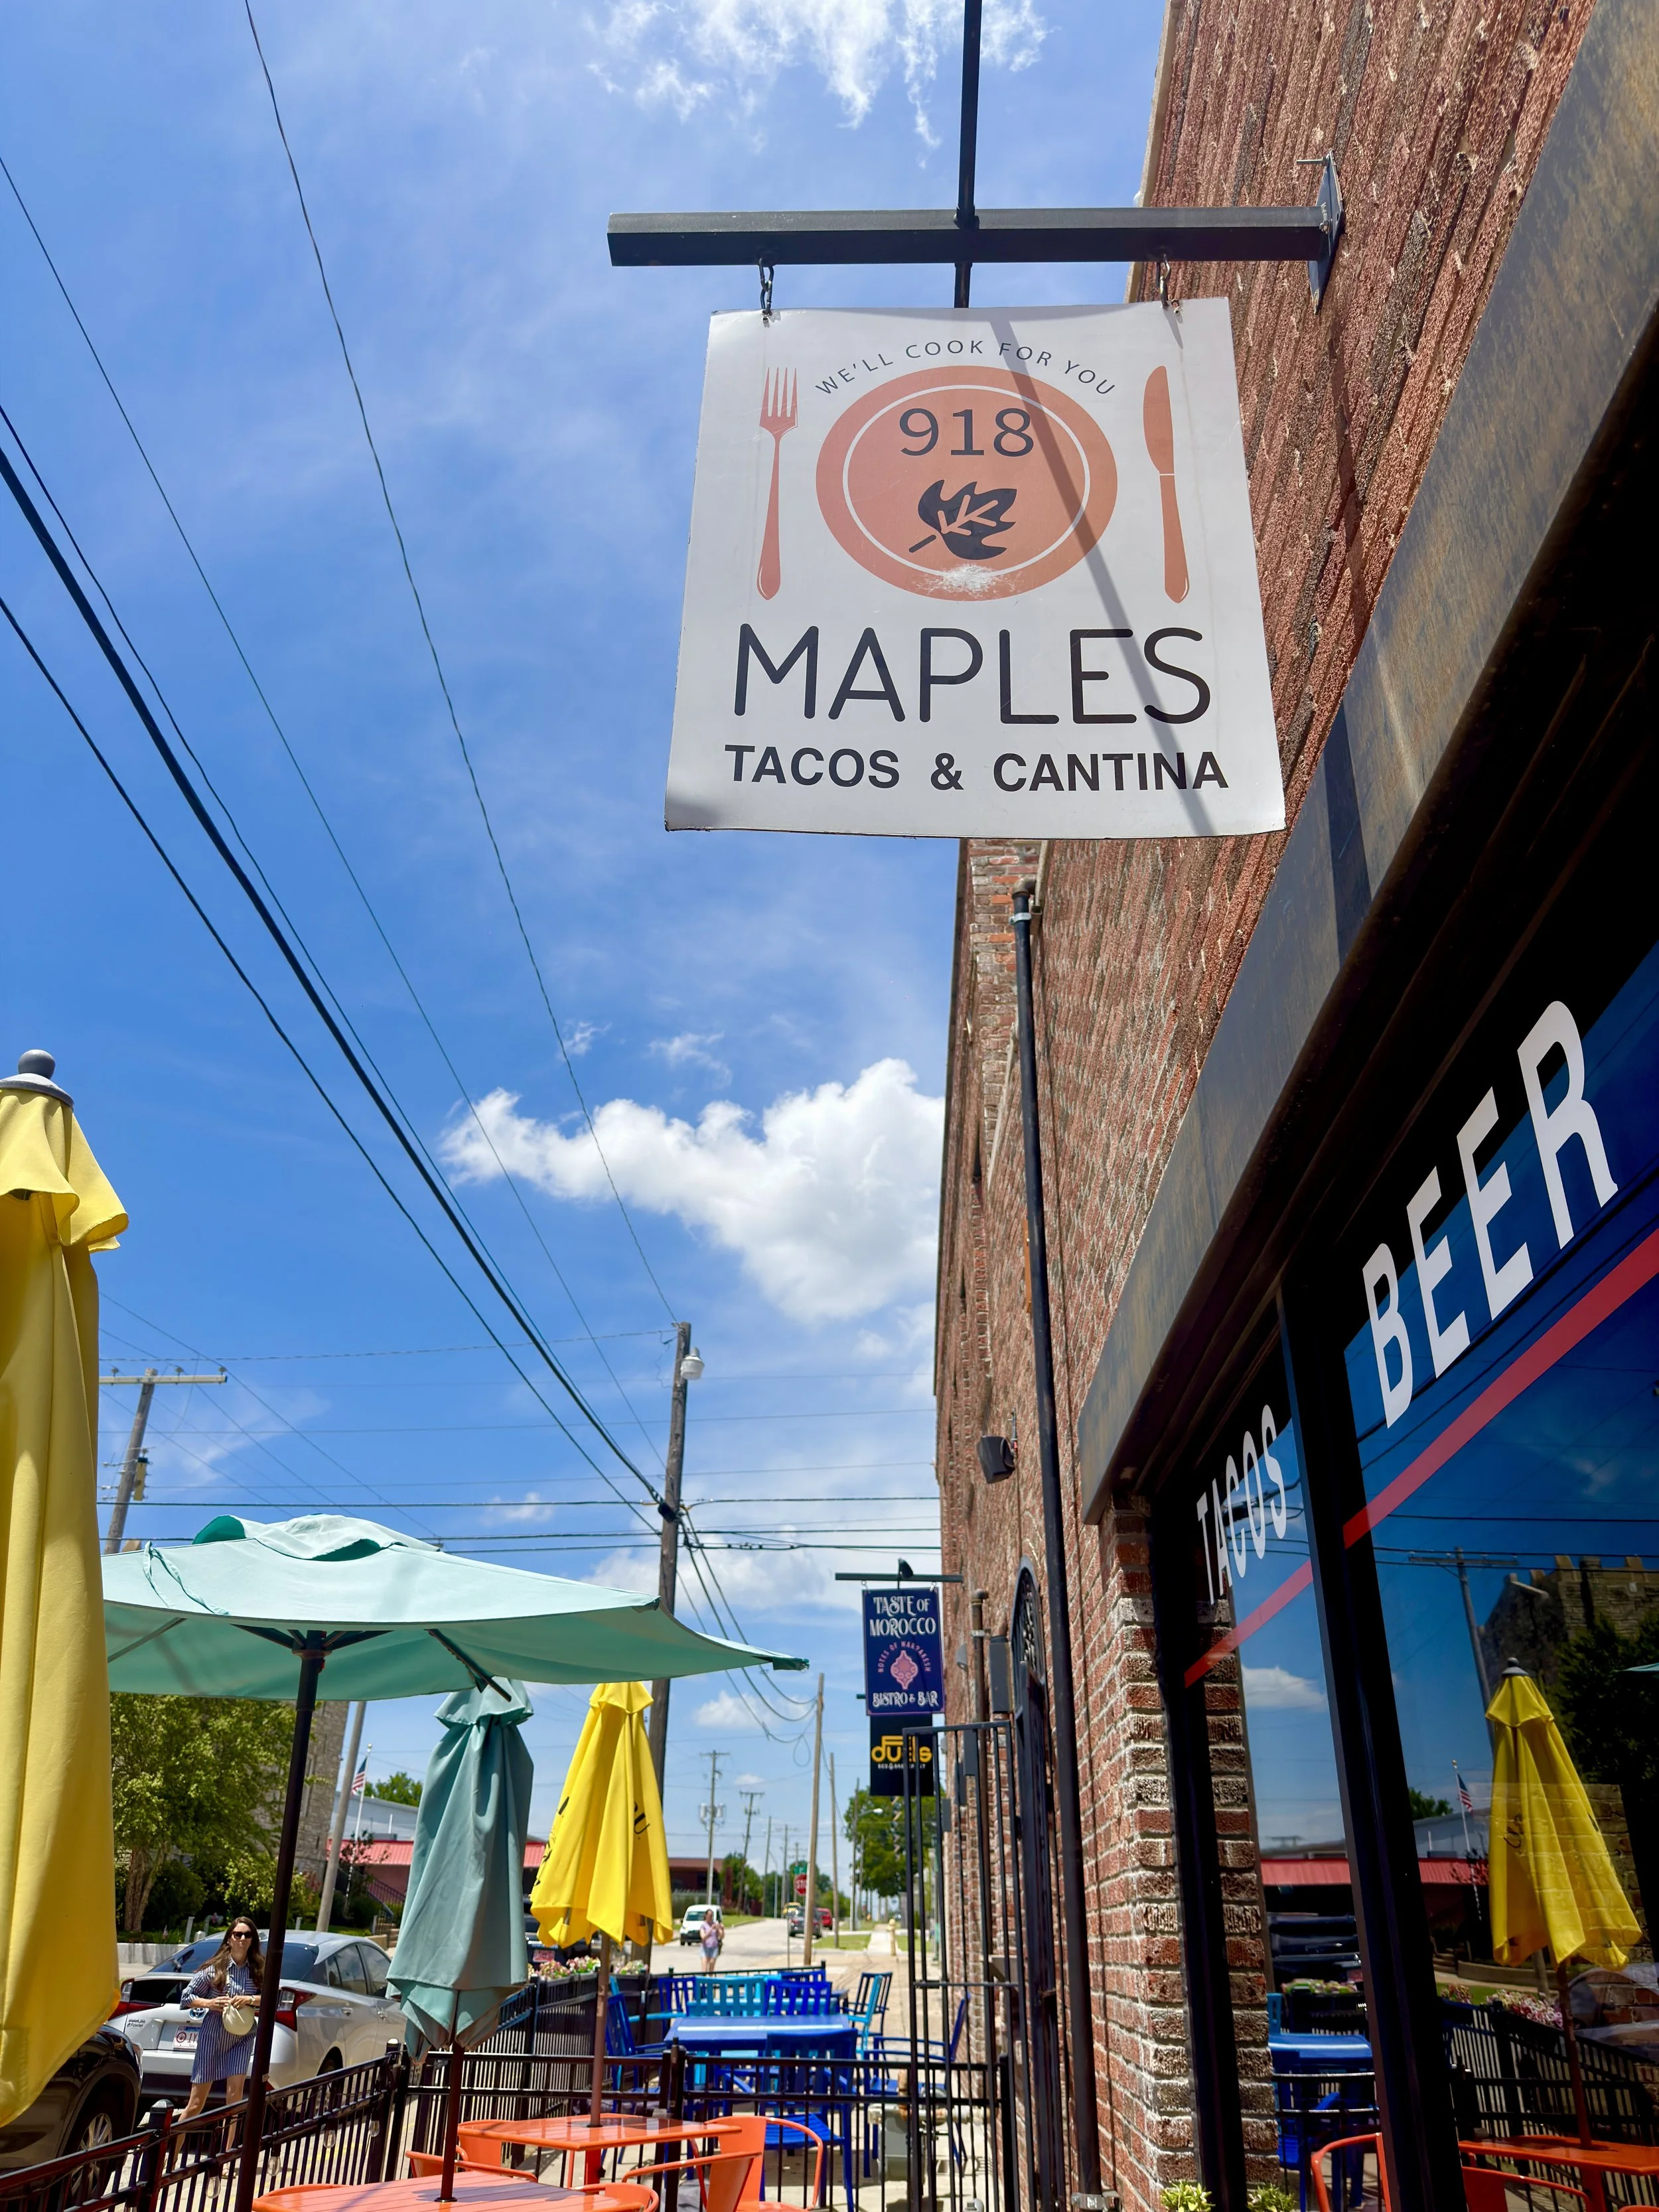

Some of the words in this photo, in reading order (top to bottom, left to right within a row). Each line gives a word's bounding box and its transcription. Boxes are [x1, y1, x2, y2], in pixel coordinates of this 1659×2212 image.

[815, 353, 893, 394] WE'LL
[906, 340, 983, 358] COOK
[999, 342, 1052, 366] FOR
[1064, 360, 1116, 395] YOU
[899, 407, 1034, 457] 918
[734, 623, 1210, 725] MAPLES
[725, 744, 900, 788] TACOS
[930, 753, 964, 790] &
[993, 751, 1229, 792] CANTINA
[1362, 1000, 1619, 1429] BEER
[1196, 1404, 1287, 1605] TACOS
[869, 1617, 936, 1639] MOROCCO
[873, 1595, 916, 1617] TASTE
[916, 1598, 930, 1612] OF
[872, 1691, 908, 1708] BISTRO
[917, 1690, 940, 1708] BAR
